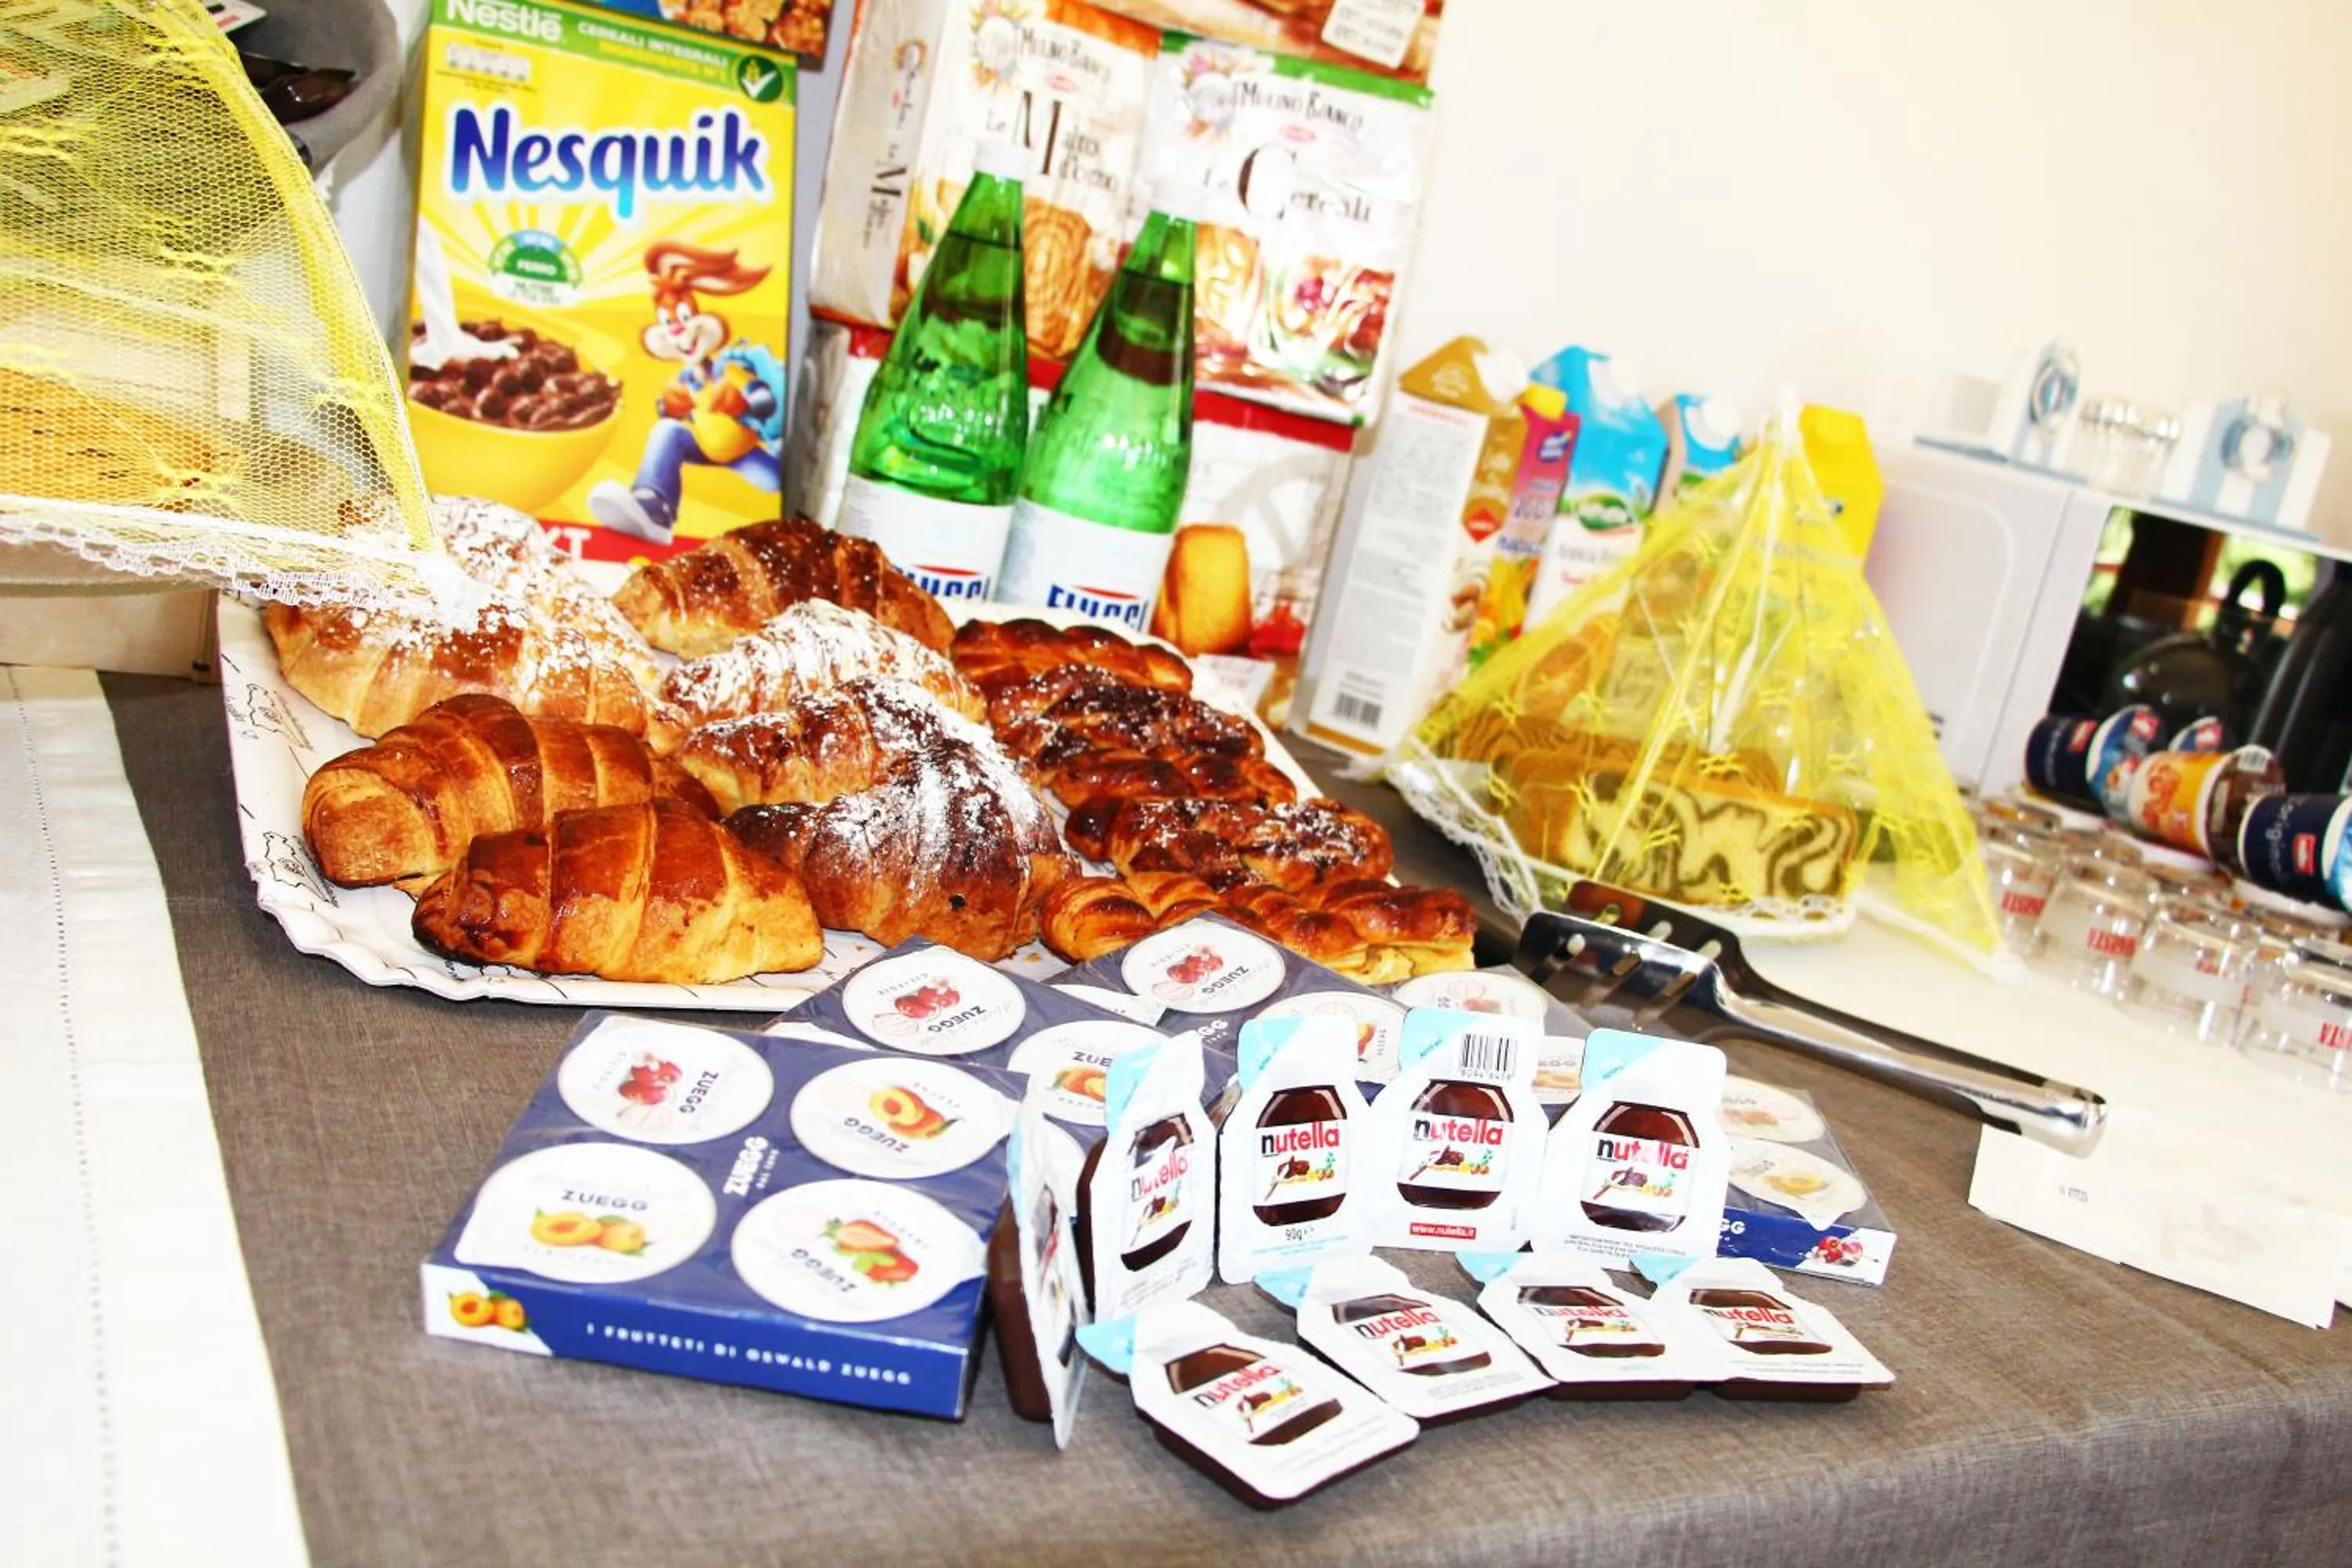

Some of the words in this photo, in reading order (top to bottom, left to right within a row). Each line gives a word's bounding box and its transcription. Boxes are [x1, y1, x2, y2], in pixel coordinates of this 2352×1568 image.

[451, 107, 766, 220] Nesquik
[1201, 965, 1250, 995] ZUEGG
[927, 1004, 987, 1033] ZUEGG
[1072, 1051, 1114, 1067] ZUE
[679, 1070, 720, 1114] ZUEGG
[843, 1116, 910, 1153] ZUEGG
[1261, 1121, 1340, 1156] nutella
[1414, 1118, 1504, 1145] nutella
[723, 1136, 769, 1196] ZUEGG
[1596, 1138, 1689, 1170] nutlla
[561, 1189, 649, 1211] ZUEGG
[1411, 1224, 1475, 1238] www.nutella.it
[792, 1248, 858, 1293] ZUEGG
[1354, 1309, 1441, 1338] nutella
[1534, 1305, 1628, 1318] nutella
[1702, 1307, 1795, 1325] nutella
[713, 1342, 737, 1358] DI
[746, 1348, 832, 1373] OSWALD
[840, 1363, 912, 1385] ZUEGG
[1192, 1364, 1283, 1409] nutella
